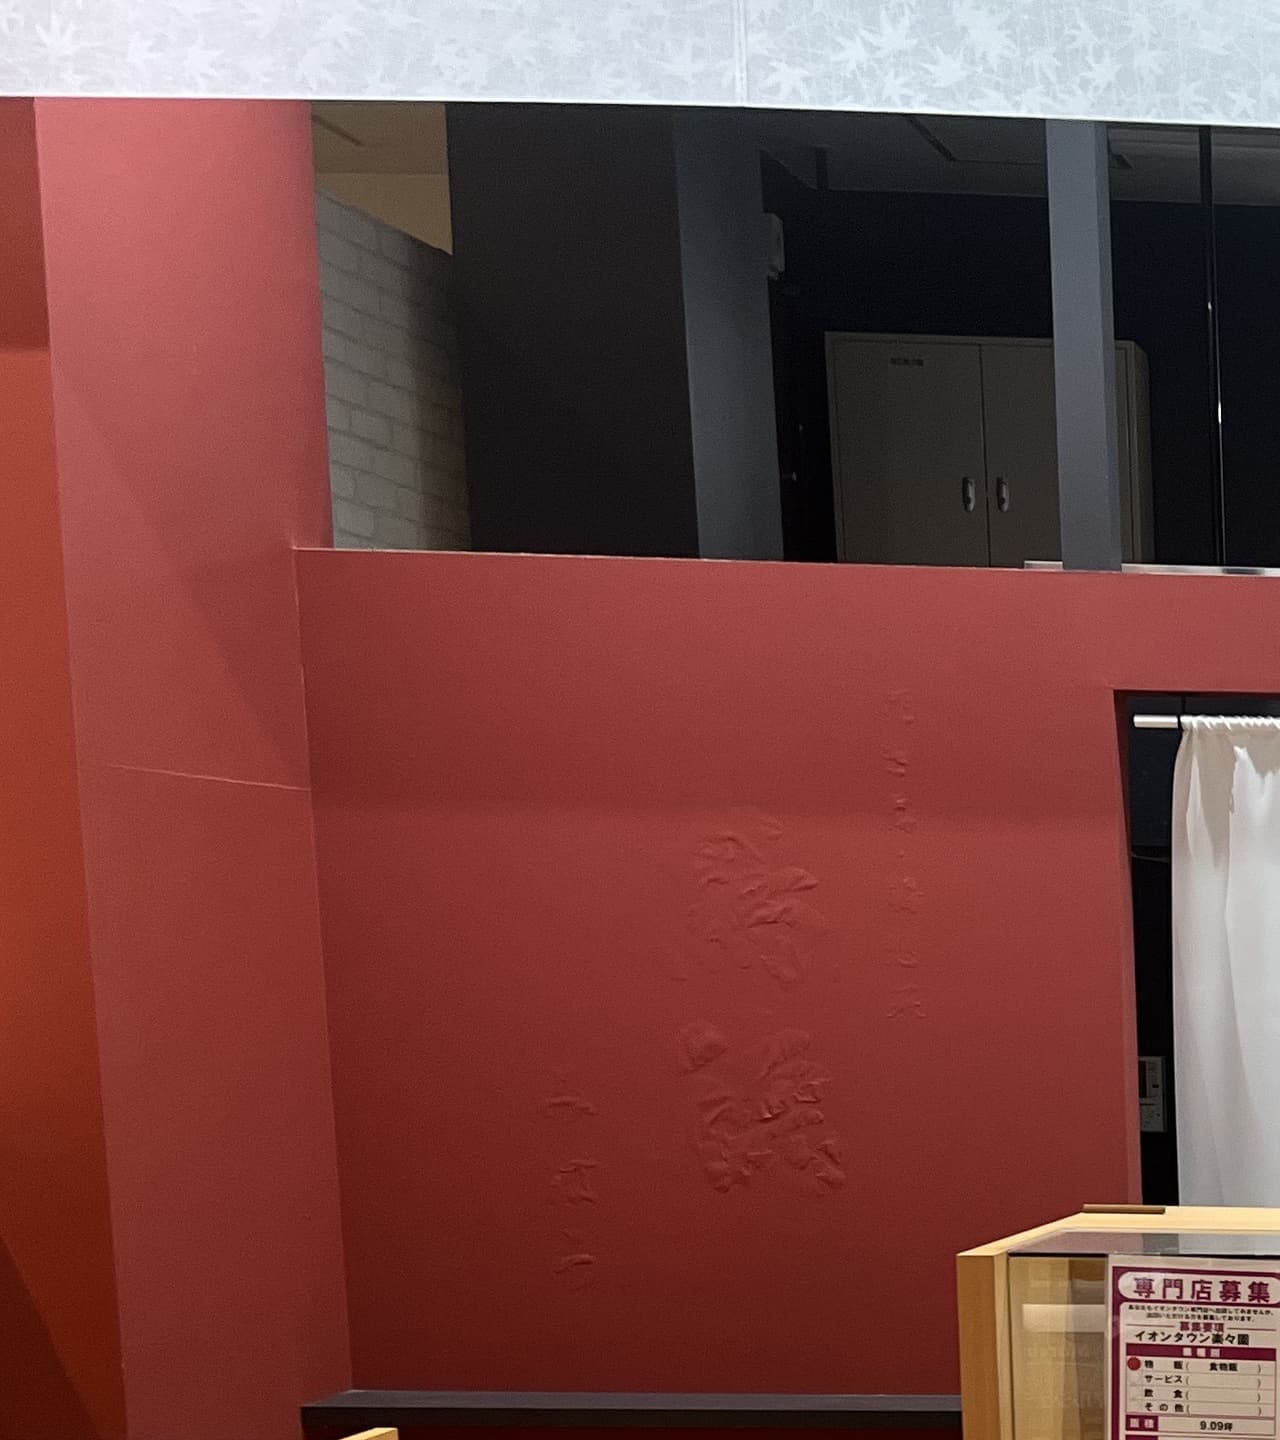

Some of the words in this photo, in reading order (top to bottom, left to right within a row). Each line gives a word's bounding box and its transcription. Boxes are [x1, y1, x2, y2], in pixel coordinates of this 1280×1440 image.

[1133, 1277, 1271, 1303] 専門店募集
[1135, 1331, 1249, 1345] イオンタウン楽々園
[1200, 1421, 1233, 1432] 9.09坪
